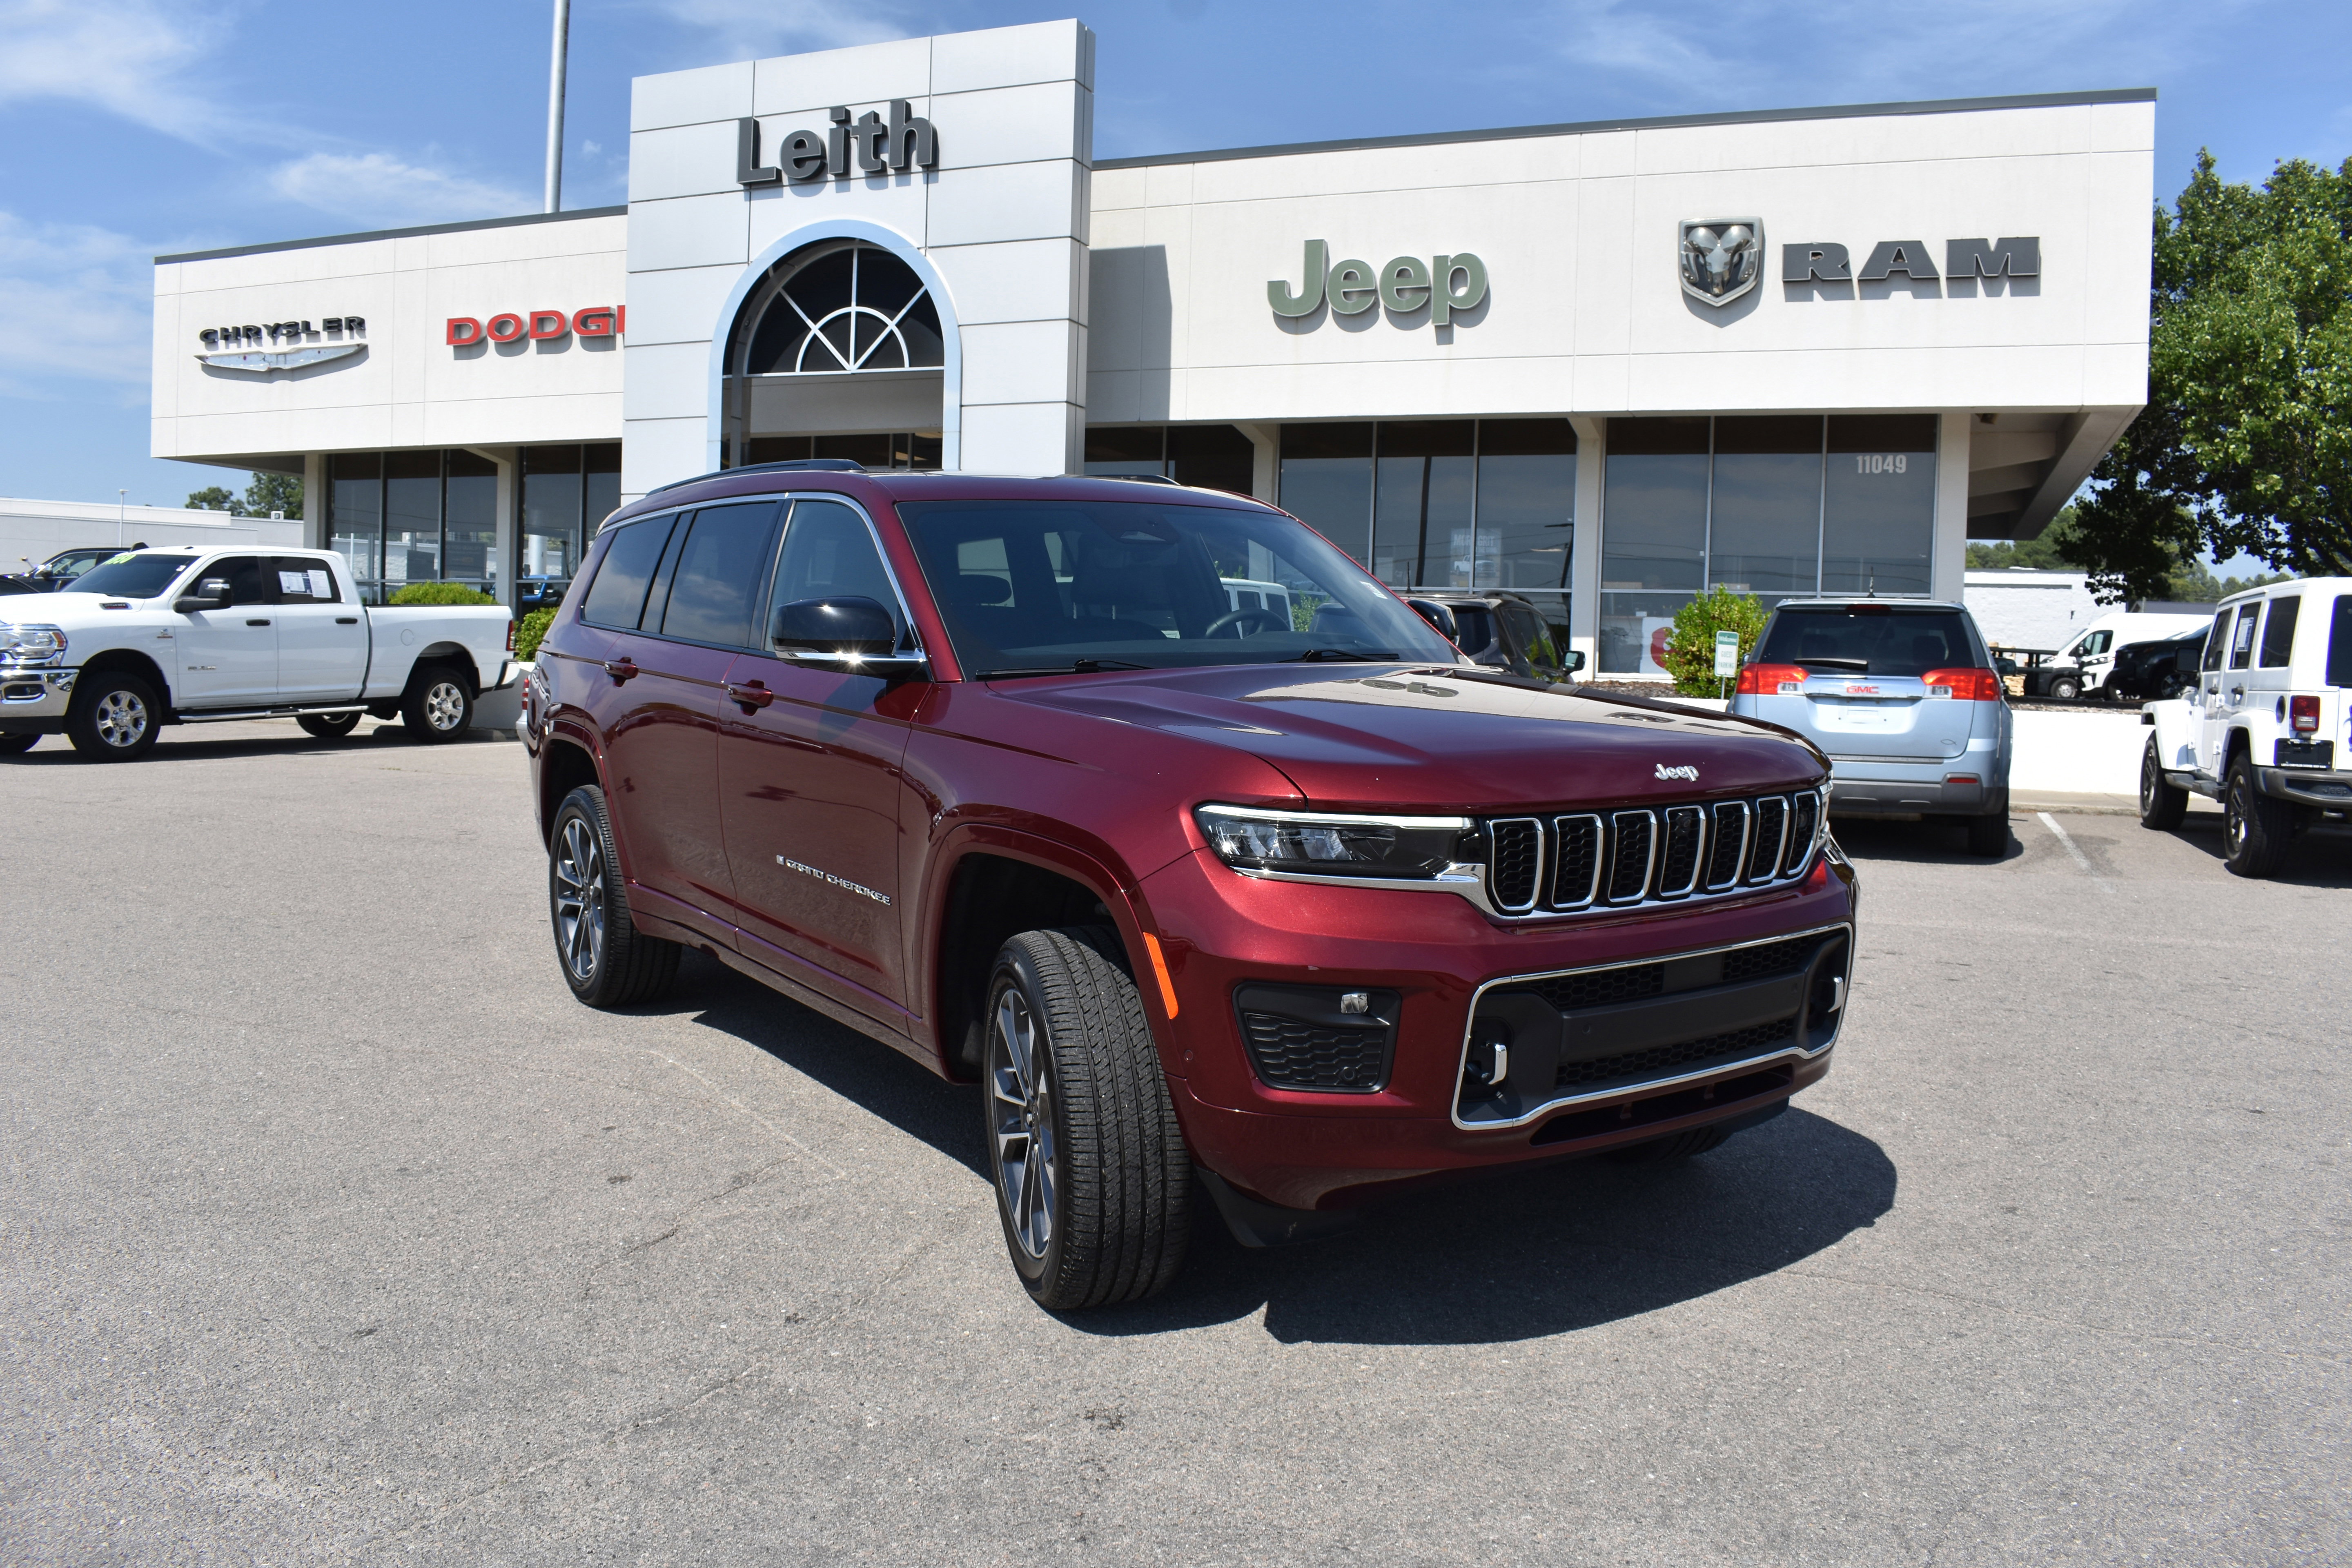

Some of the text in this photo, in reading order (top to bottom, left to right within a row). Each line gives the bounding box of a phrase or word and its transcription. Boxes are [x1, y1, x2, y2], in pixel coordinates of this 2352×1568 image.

[736, 99, 938, 185] Leith
[1782, 236, 2041, 281] RAM
[1267, 239, 1489, 326] Jeep
[199, 316, 366, 344] CHRYSLER
[446, 305, 625, 345] DODG
[1856, 454, 1907, 474] 11049
[1846, 686, 1880, 694] GMC
[1654, 764, 1699, 782] Jeep
[2322, 786, 2348, 796] Jeep
[786, 859, 892, 906] GRAND CHEROKEE
